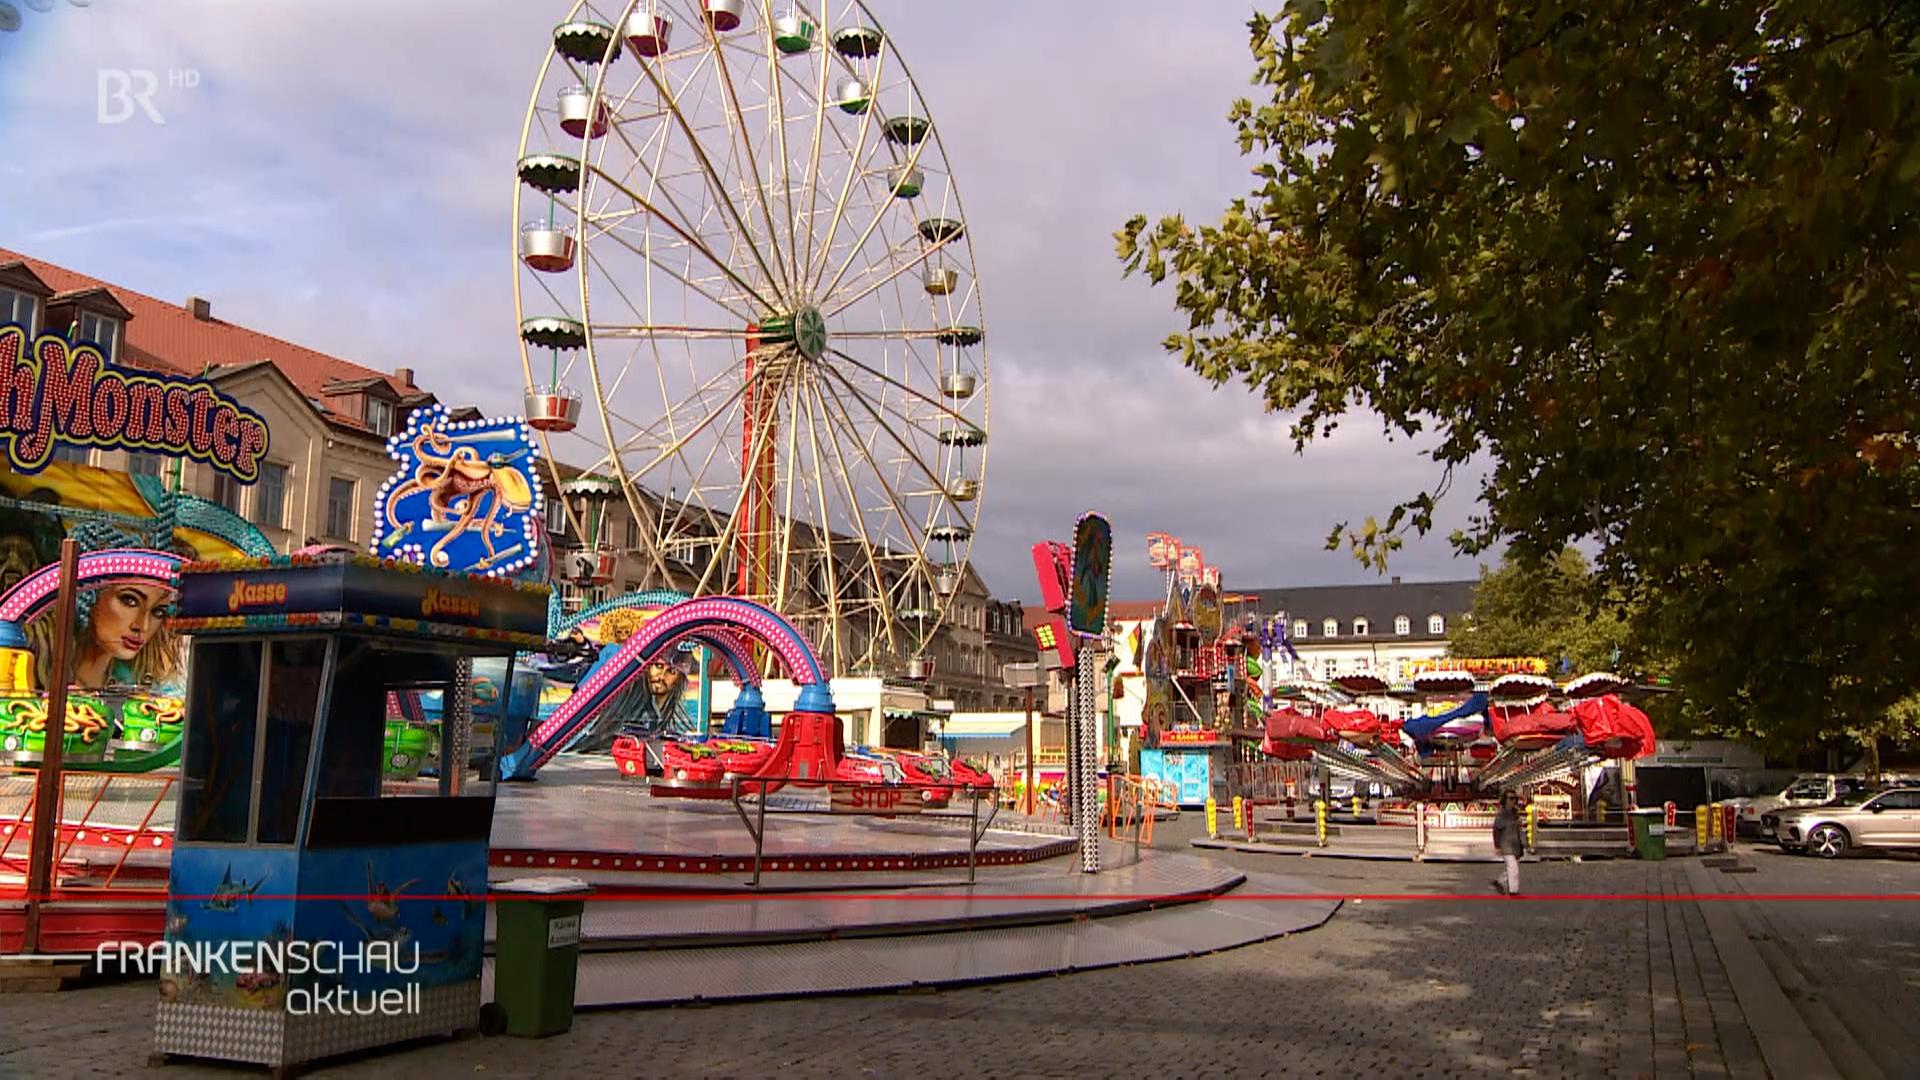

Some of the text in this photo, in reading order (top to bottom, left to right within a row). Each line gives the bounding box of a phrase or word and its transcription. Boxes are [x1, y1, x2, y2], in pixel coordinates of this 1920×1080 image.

[228, 579, 288, 611] Kasse
[421, 586, 481, 616] Kasse
[851, 787, 902, 809] STOP
